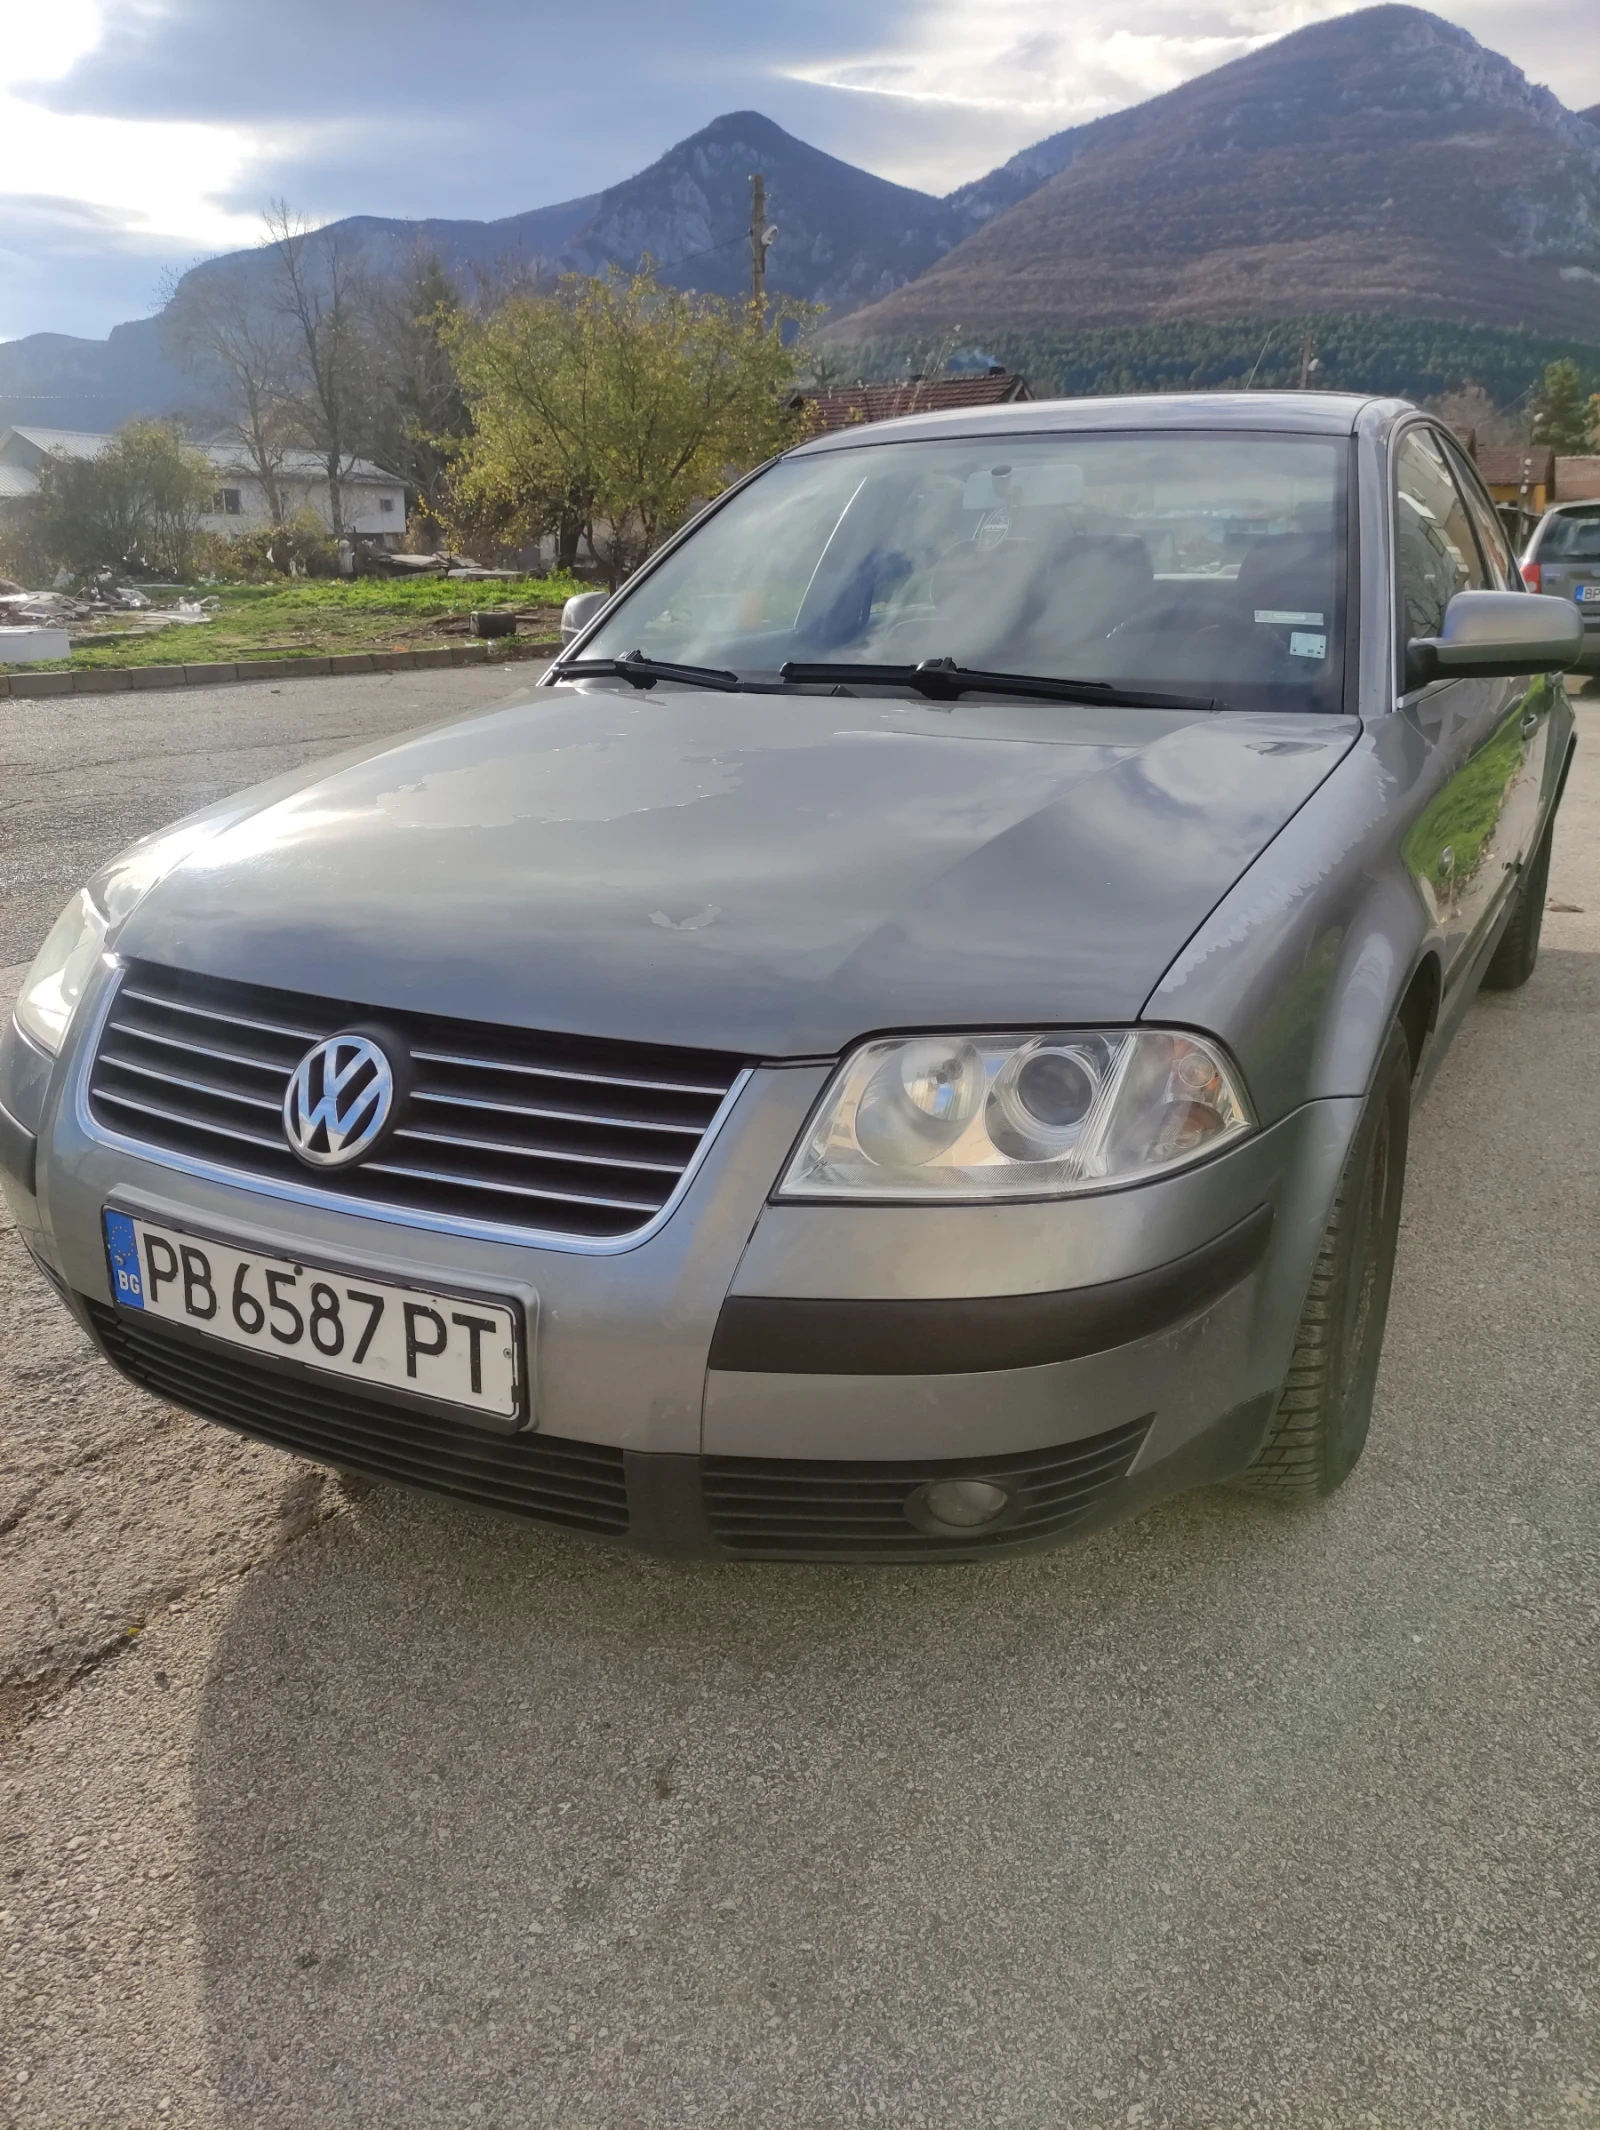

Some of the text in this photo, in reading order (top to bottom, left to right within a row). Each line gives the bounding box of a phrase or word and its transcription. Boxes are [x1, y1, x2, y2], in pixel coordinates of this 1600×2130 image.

[1585, 588, 1600, 600] BP
[118, 1269, 140, 1295] BG
[142, 1232, 497, 1394] PB 6587 PT
